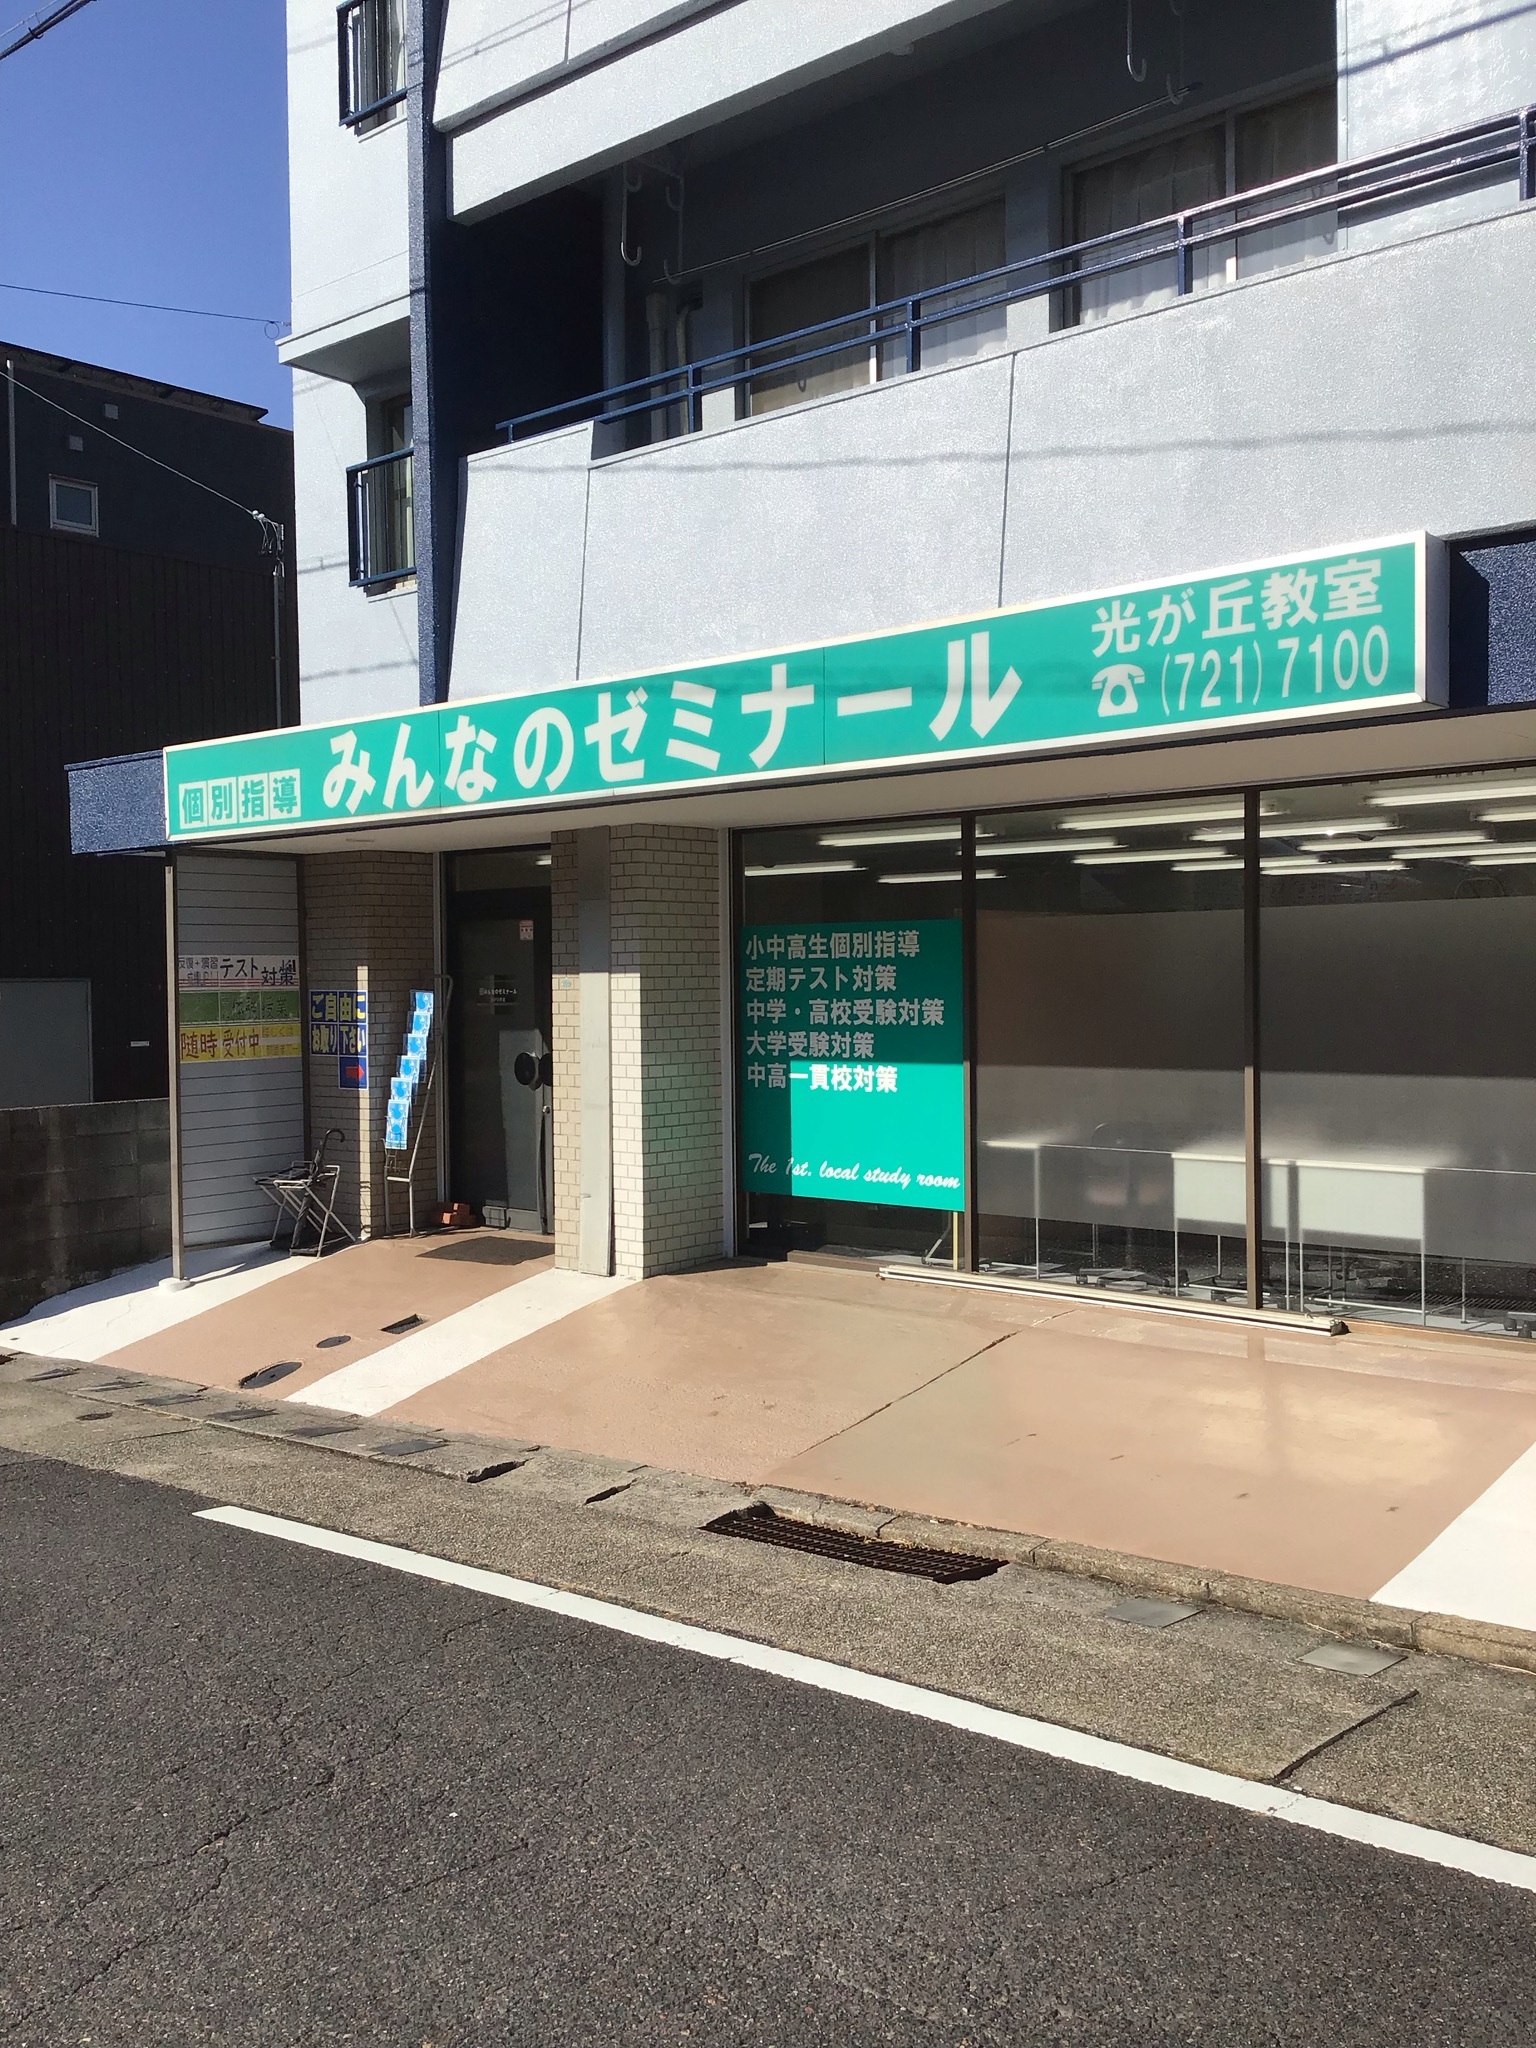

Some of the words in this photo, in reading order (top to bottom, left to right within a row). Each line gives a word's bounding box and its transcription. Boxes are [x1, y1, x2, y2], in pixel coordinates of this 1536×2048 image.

[1091, 558, 1382, 656] 光が丘教室
[1160, 629, 1388, 714] (721)7100
[321, 631, 1022, 813] みんなのゼミナール
[181, 774, 299, 827] 個別指導
[746, 930, 919, 959] 小中高生個別指導
[745, 964, 898, 992] 定期テスト対策
[312, 994, 365, 1021] ご自由に
[745, 998, 945, 1026] 中学・高校受験対策
[181, 1029, 259, 1060] 随時受付中
[312, 1026, 365, 1053] お取り下さい
[746, 1031, 875, 1059] 大学受験対策
[747, 1063, 898, 1093] 中高一貫校対策
[748, 1153, 777, 1174] The
[819, 1160, 860, 1181] local
[863, 1166, 912, 1190] study
[916, 1173, 961, 1189] room
